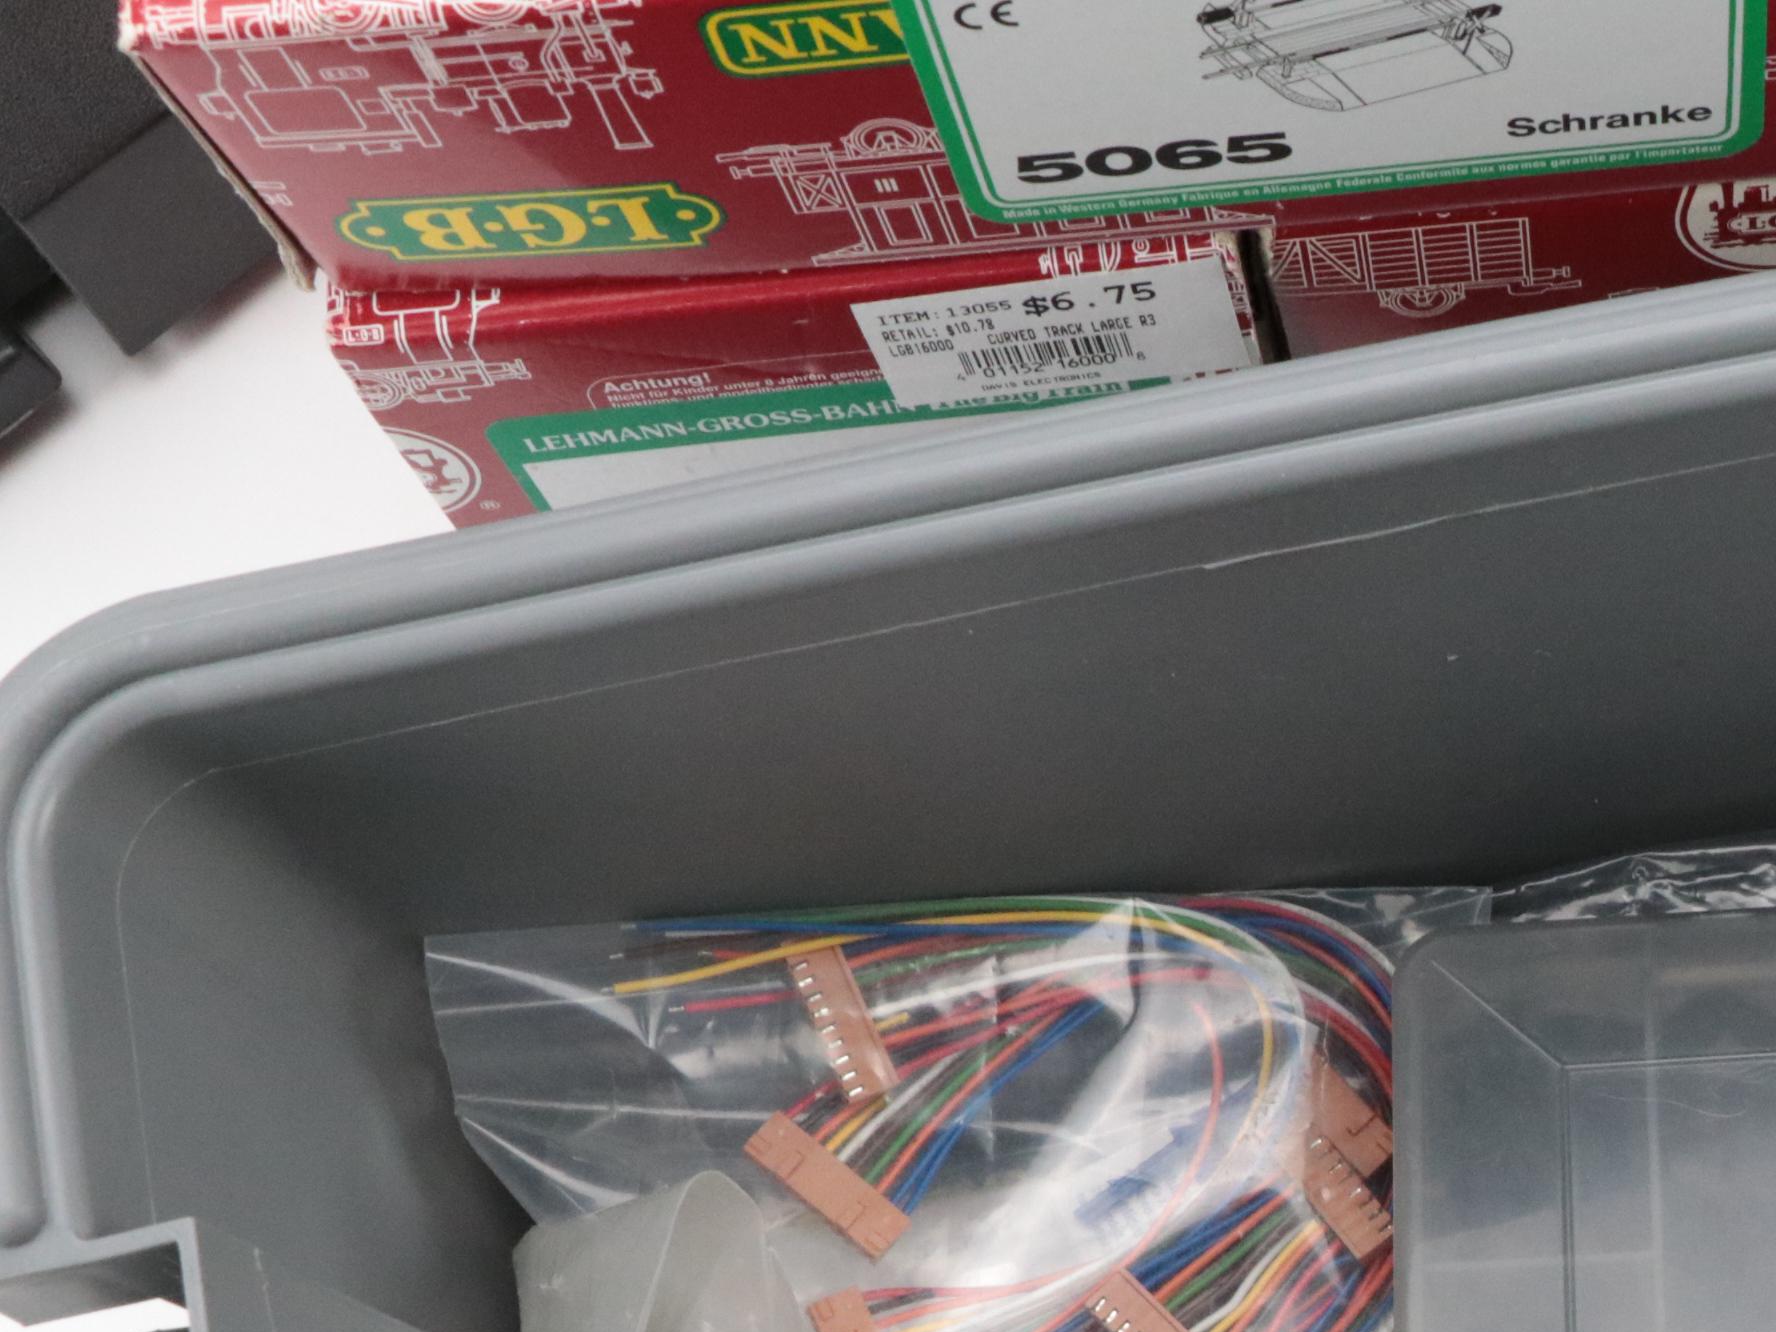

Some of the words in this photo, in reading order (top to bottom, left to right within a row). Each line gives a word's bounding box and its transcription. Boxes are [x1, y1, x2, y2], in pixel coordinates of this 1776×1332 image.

[1506, 104, 1713, 139] Schranke
[1016, 132, 1293, 184] 5065
[946, 300, 1011, 316] 13055
[882, 327, 937, 342] RETAIL:
[946, 318, 994, 335] $10.78
[889, 338, 954, 356] LGB16000
[987, 328, 1036, 344] CURVED
[1044, 322, 1083, 336] TRACK
[1090, 317, 1132, 331] LARGE
[1139, 313, 1156, 326] R3
[603, 371, 711, 393] Achtung!
[606, 392, 645, 404] Nicht
[671, 384, 722, 397] Kinder
[724, 380, 761, 392] unter
[777, 372, 828, 387] Jahren
